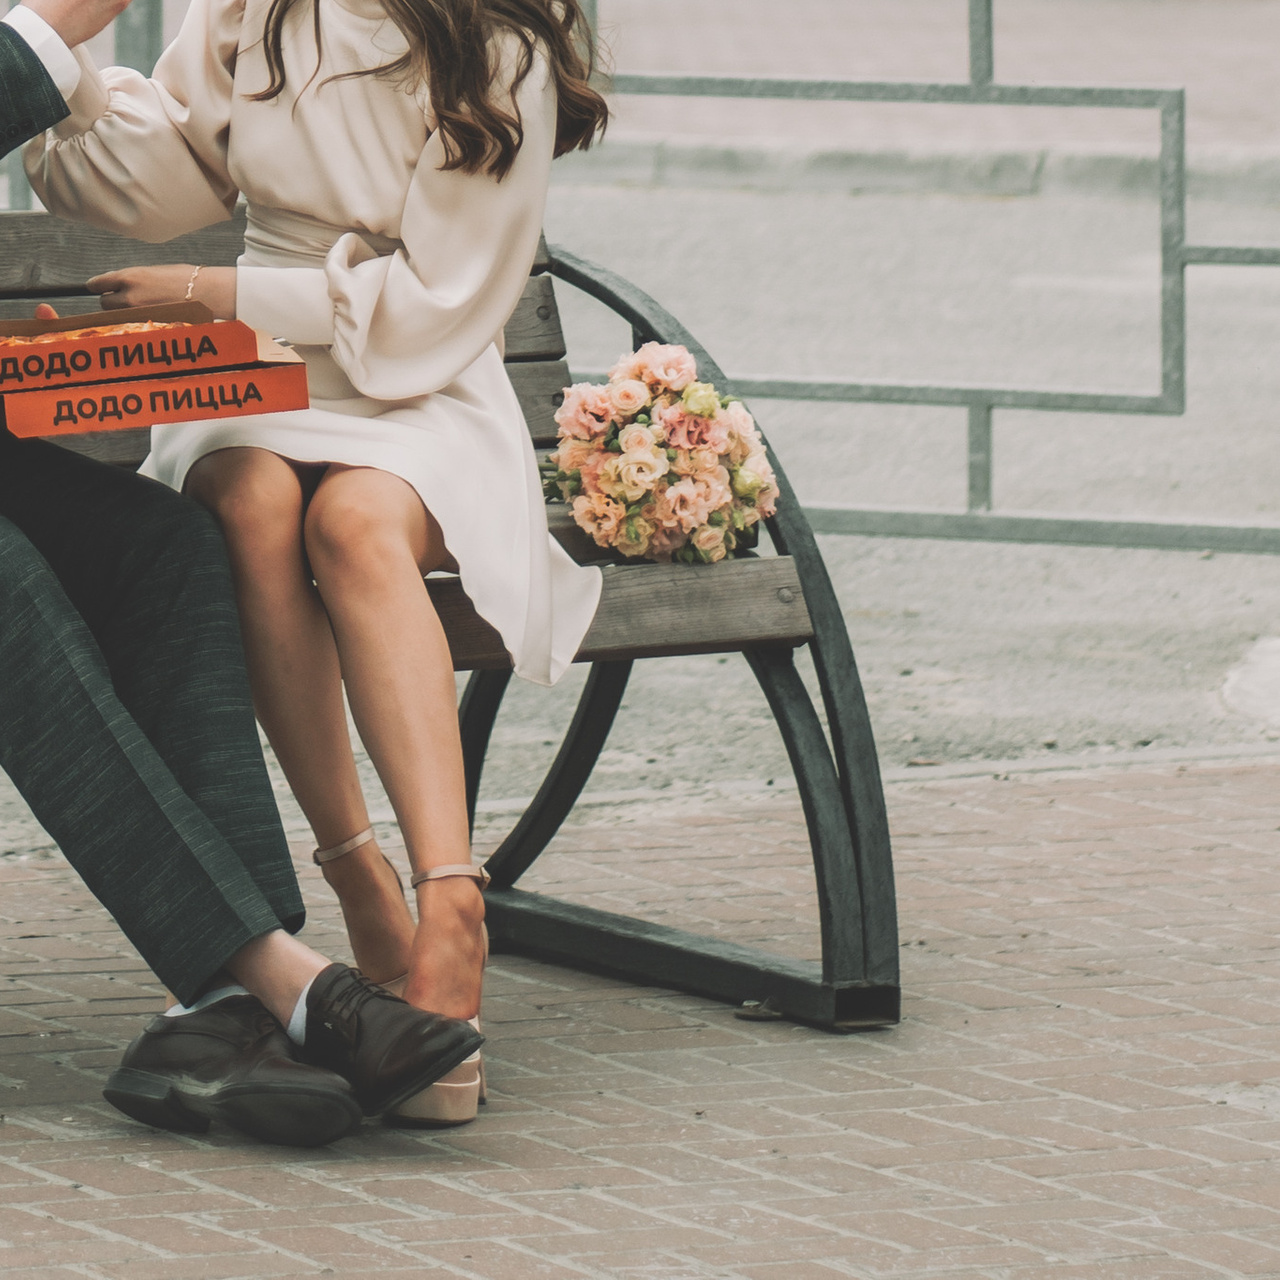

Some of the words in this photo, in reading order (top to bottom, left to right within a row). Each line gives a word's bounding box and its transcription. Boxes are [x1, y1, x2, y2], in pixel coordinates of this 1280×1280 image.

[99, 335, 218, 369] ПИЦЦА
[53, 394, 142, 426] ДОДО
[149, 382, 263, 412] ПИЦЦА
